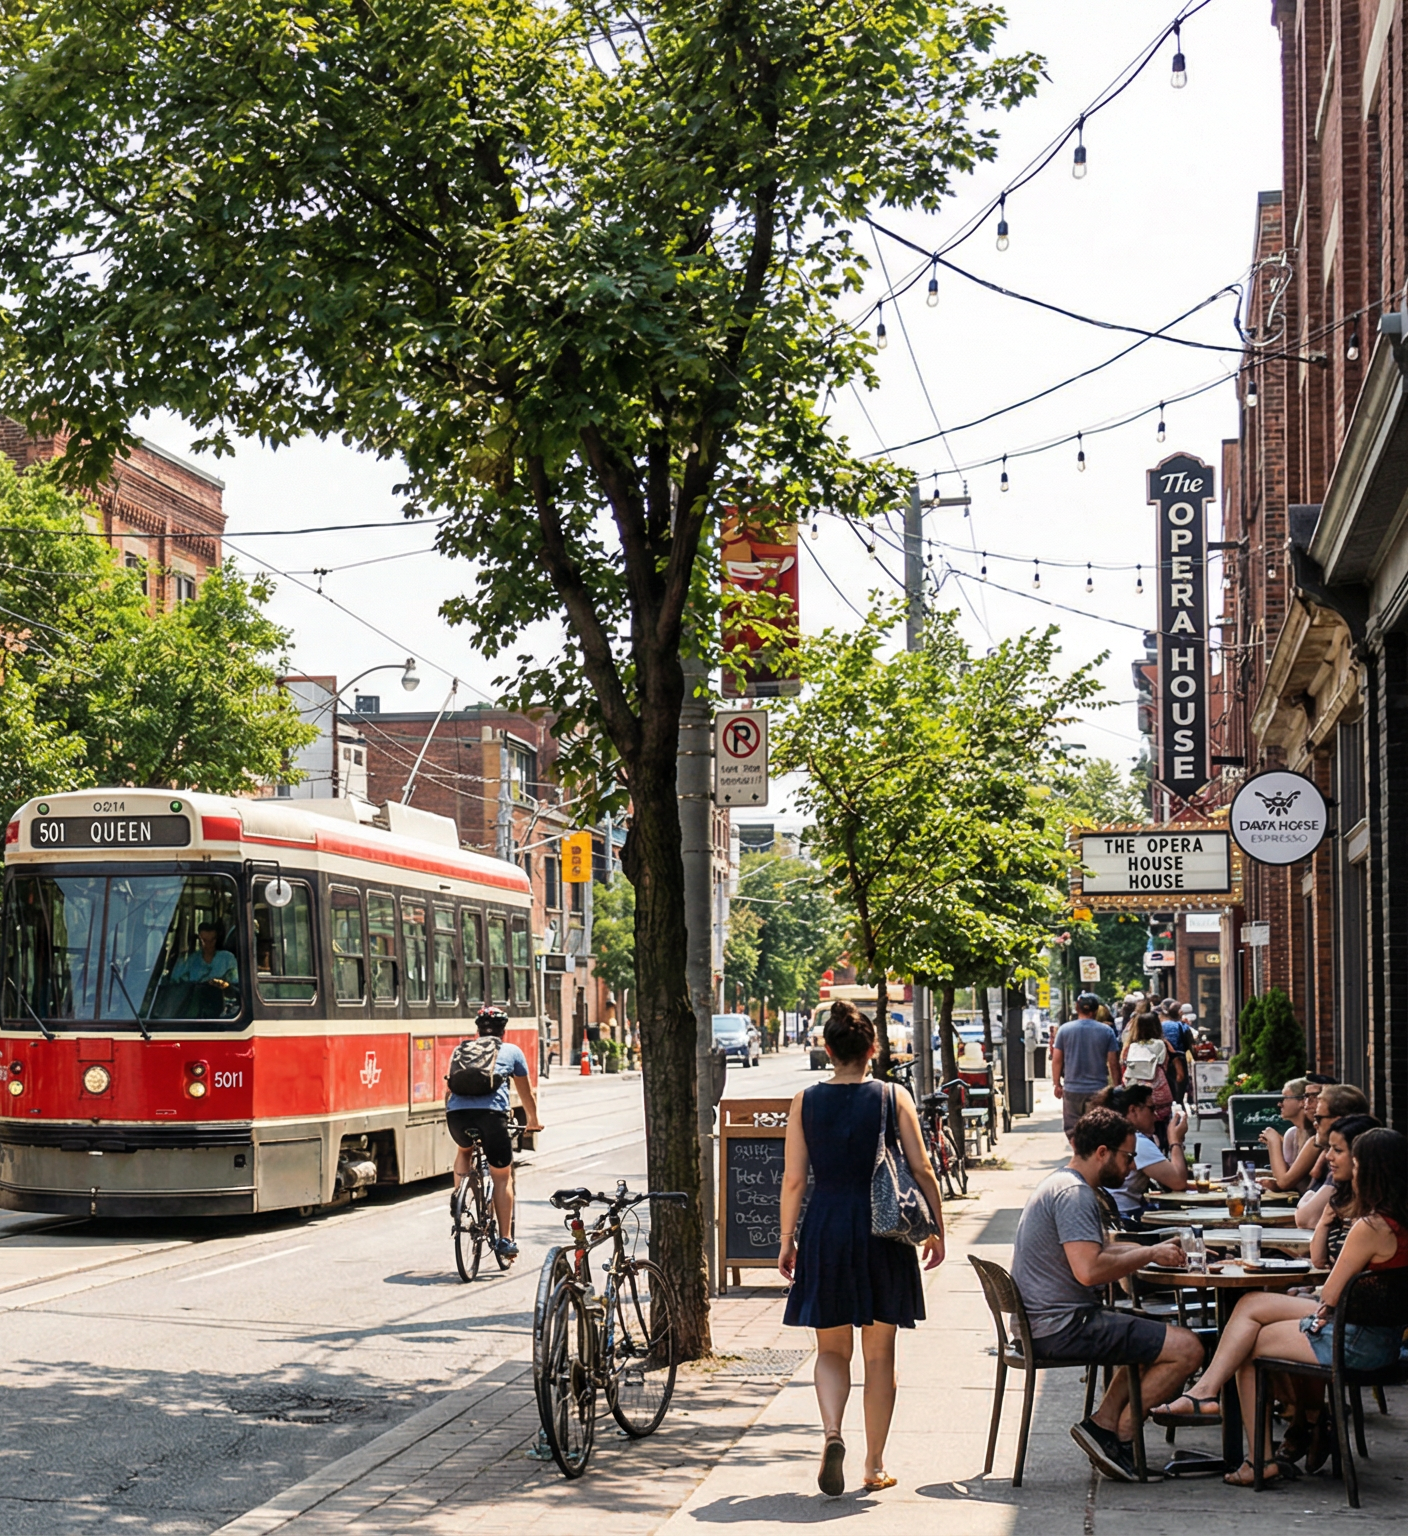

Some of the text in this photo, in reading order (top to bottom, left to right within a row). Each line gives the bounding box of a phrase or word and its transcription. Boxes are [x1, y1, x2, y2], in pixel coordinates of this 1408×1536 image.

[1159, 471, 1204, 494] The
[1168, 502, 1197, 780] OPERA HOUSE
[39, 821, 152, 843] 501 QUEEN
[1104, 837, 1204, 854] THE OPERA
[1128, 856, 1183, 871] HOUSE
[1129, 874, 1184, 889] HOUSE
